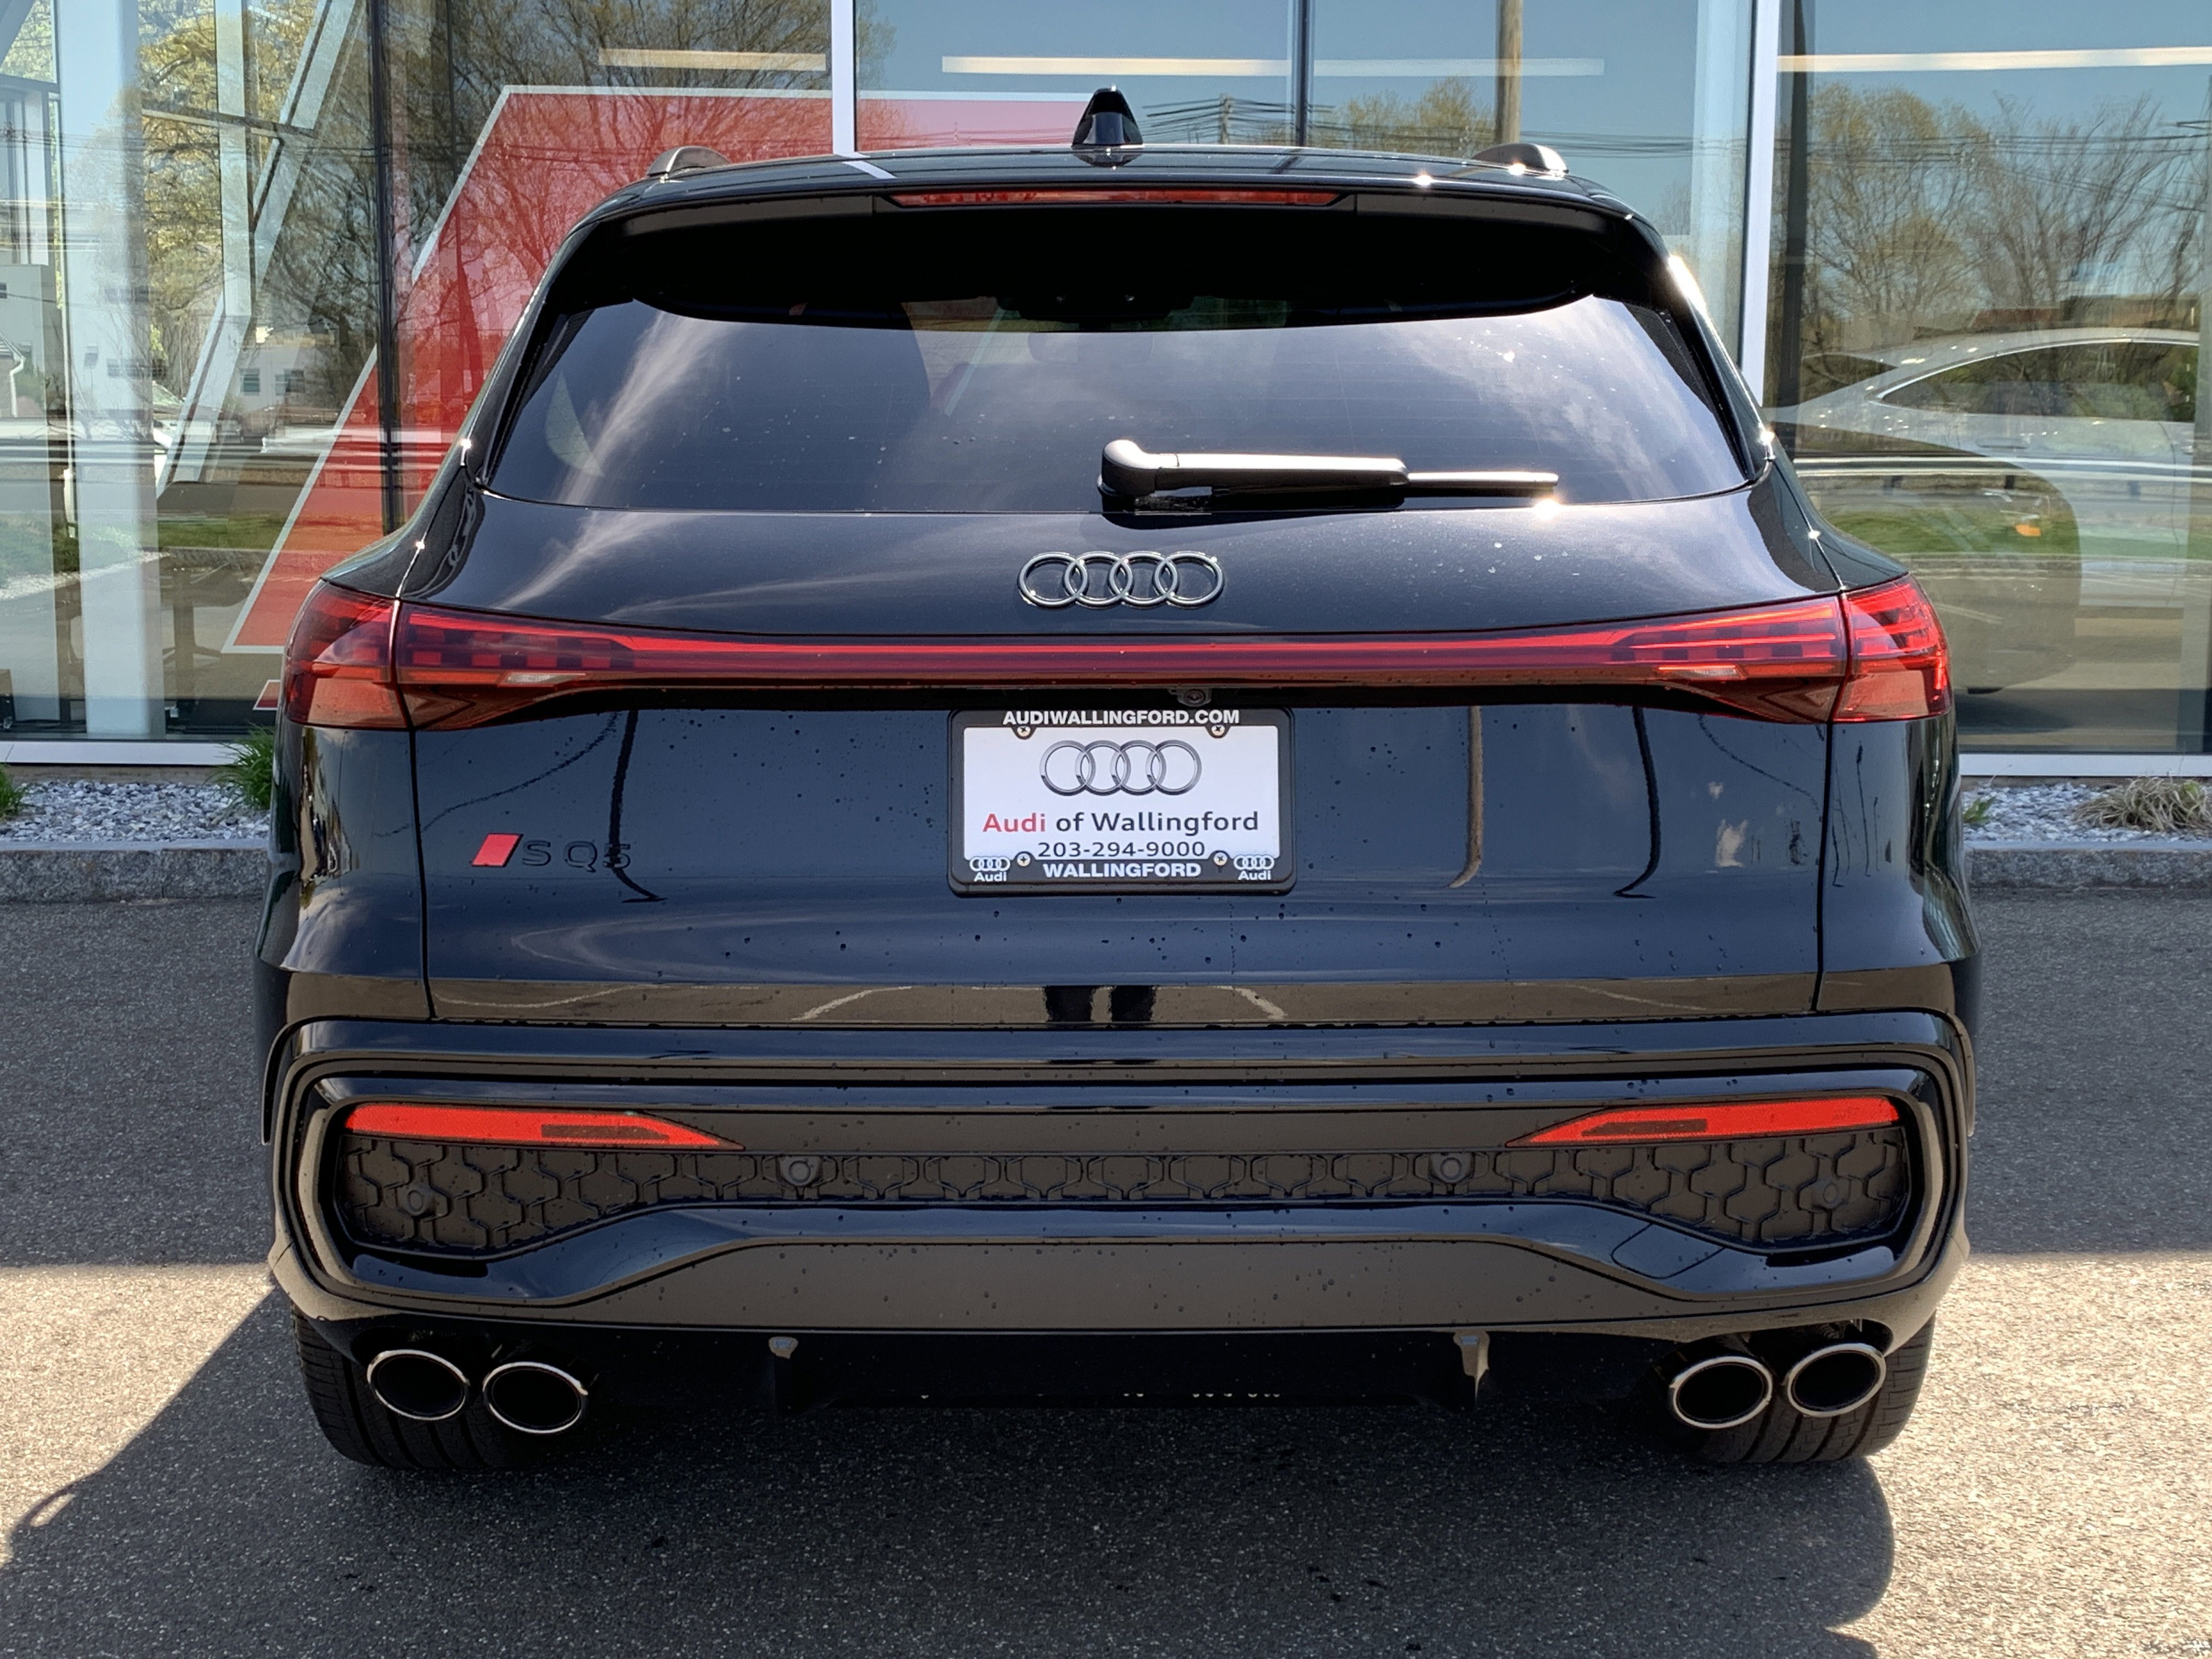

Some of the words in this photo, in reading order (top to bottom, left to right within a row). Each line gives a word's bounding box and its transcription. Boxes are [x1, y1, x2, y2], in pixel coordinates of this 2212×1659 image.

[1002, 710, 1239, 725] AUDIWALLINGFORD.COM
[983, 812, 1046, 832] Audi
[1056, 812, 1085, 832] of
[1091, 811, 1259, 836] Wallingford
[1037, 841, 1205, 857] 203-294-9000
[974, 871, 1007, 882] Audi
[1043, 862, 1201, 878] WALLINGFORD
[1238, 870, 1271, 881] Audi
